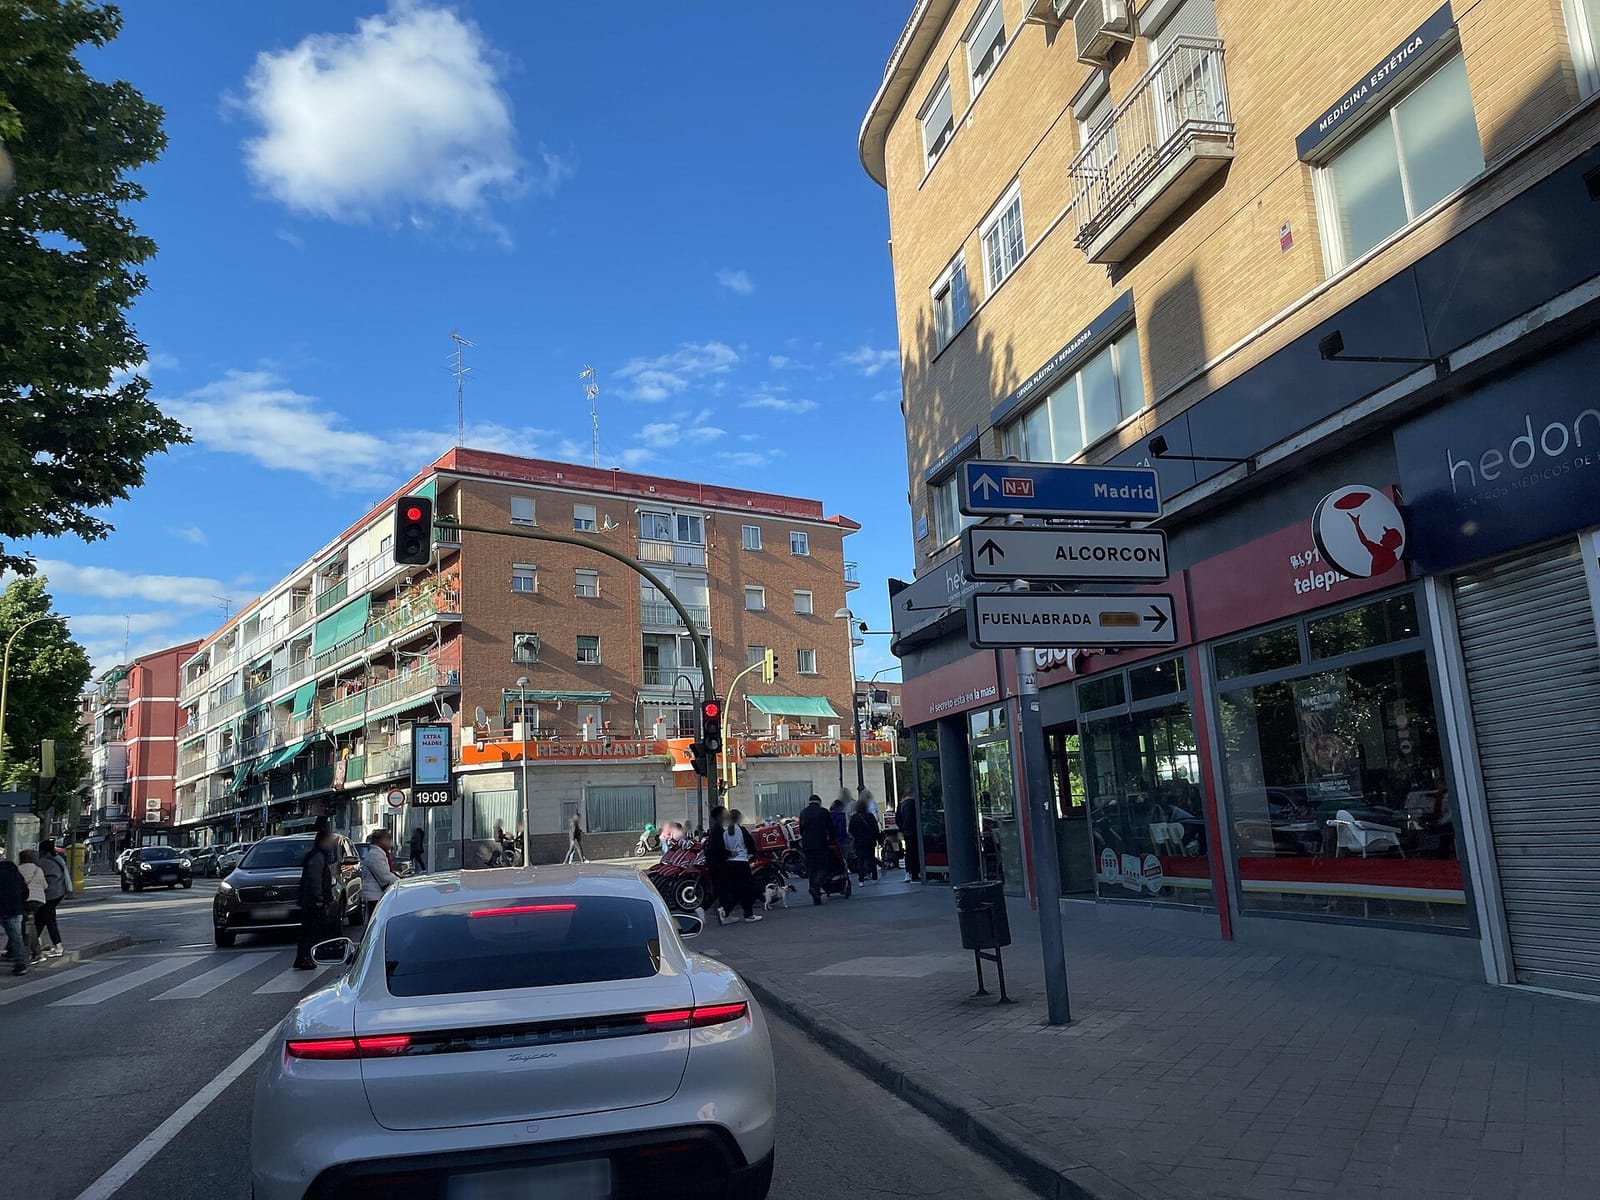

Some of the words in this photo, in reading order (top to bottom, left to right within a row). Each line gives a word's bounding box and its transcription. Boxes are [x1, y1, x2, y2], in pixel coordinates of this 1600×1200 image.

[1319, 85, 1368, 132] MEDICINA
[1370, 36, 1423, 87] ESTÉTICA
[1059, 330, 1092, 362] REPARADORA
[1574, 455, 1592, 469] DE
[1005, 481, 1030, 495] N-V
[1094, 483, 1154, 499] Madrid
[1055, 545, 1161, 562] ALCORCON
[982, 612, 1092, 626] FUENLABRADA
[935, 699, 954, 712] secreto
[966, 692, 974, 703] en
[973, 687, 980, 700] la
[980, 685, 996, 698] masa
[536, 742, 656, 757] RESTAURANTE
[761, 742, 800, 754] CHINO
[416, 791, 448, 804] 19:09
[451, 1025, 609, 1046] PORSCHE
